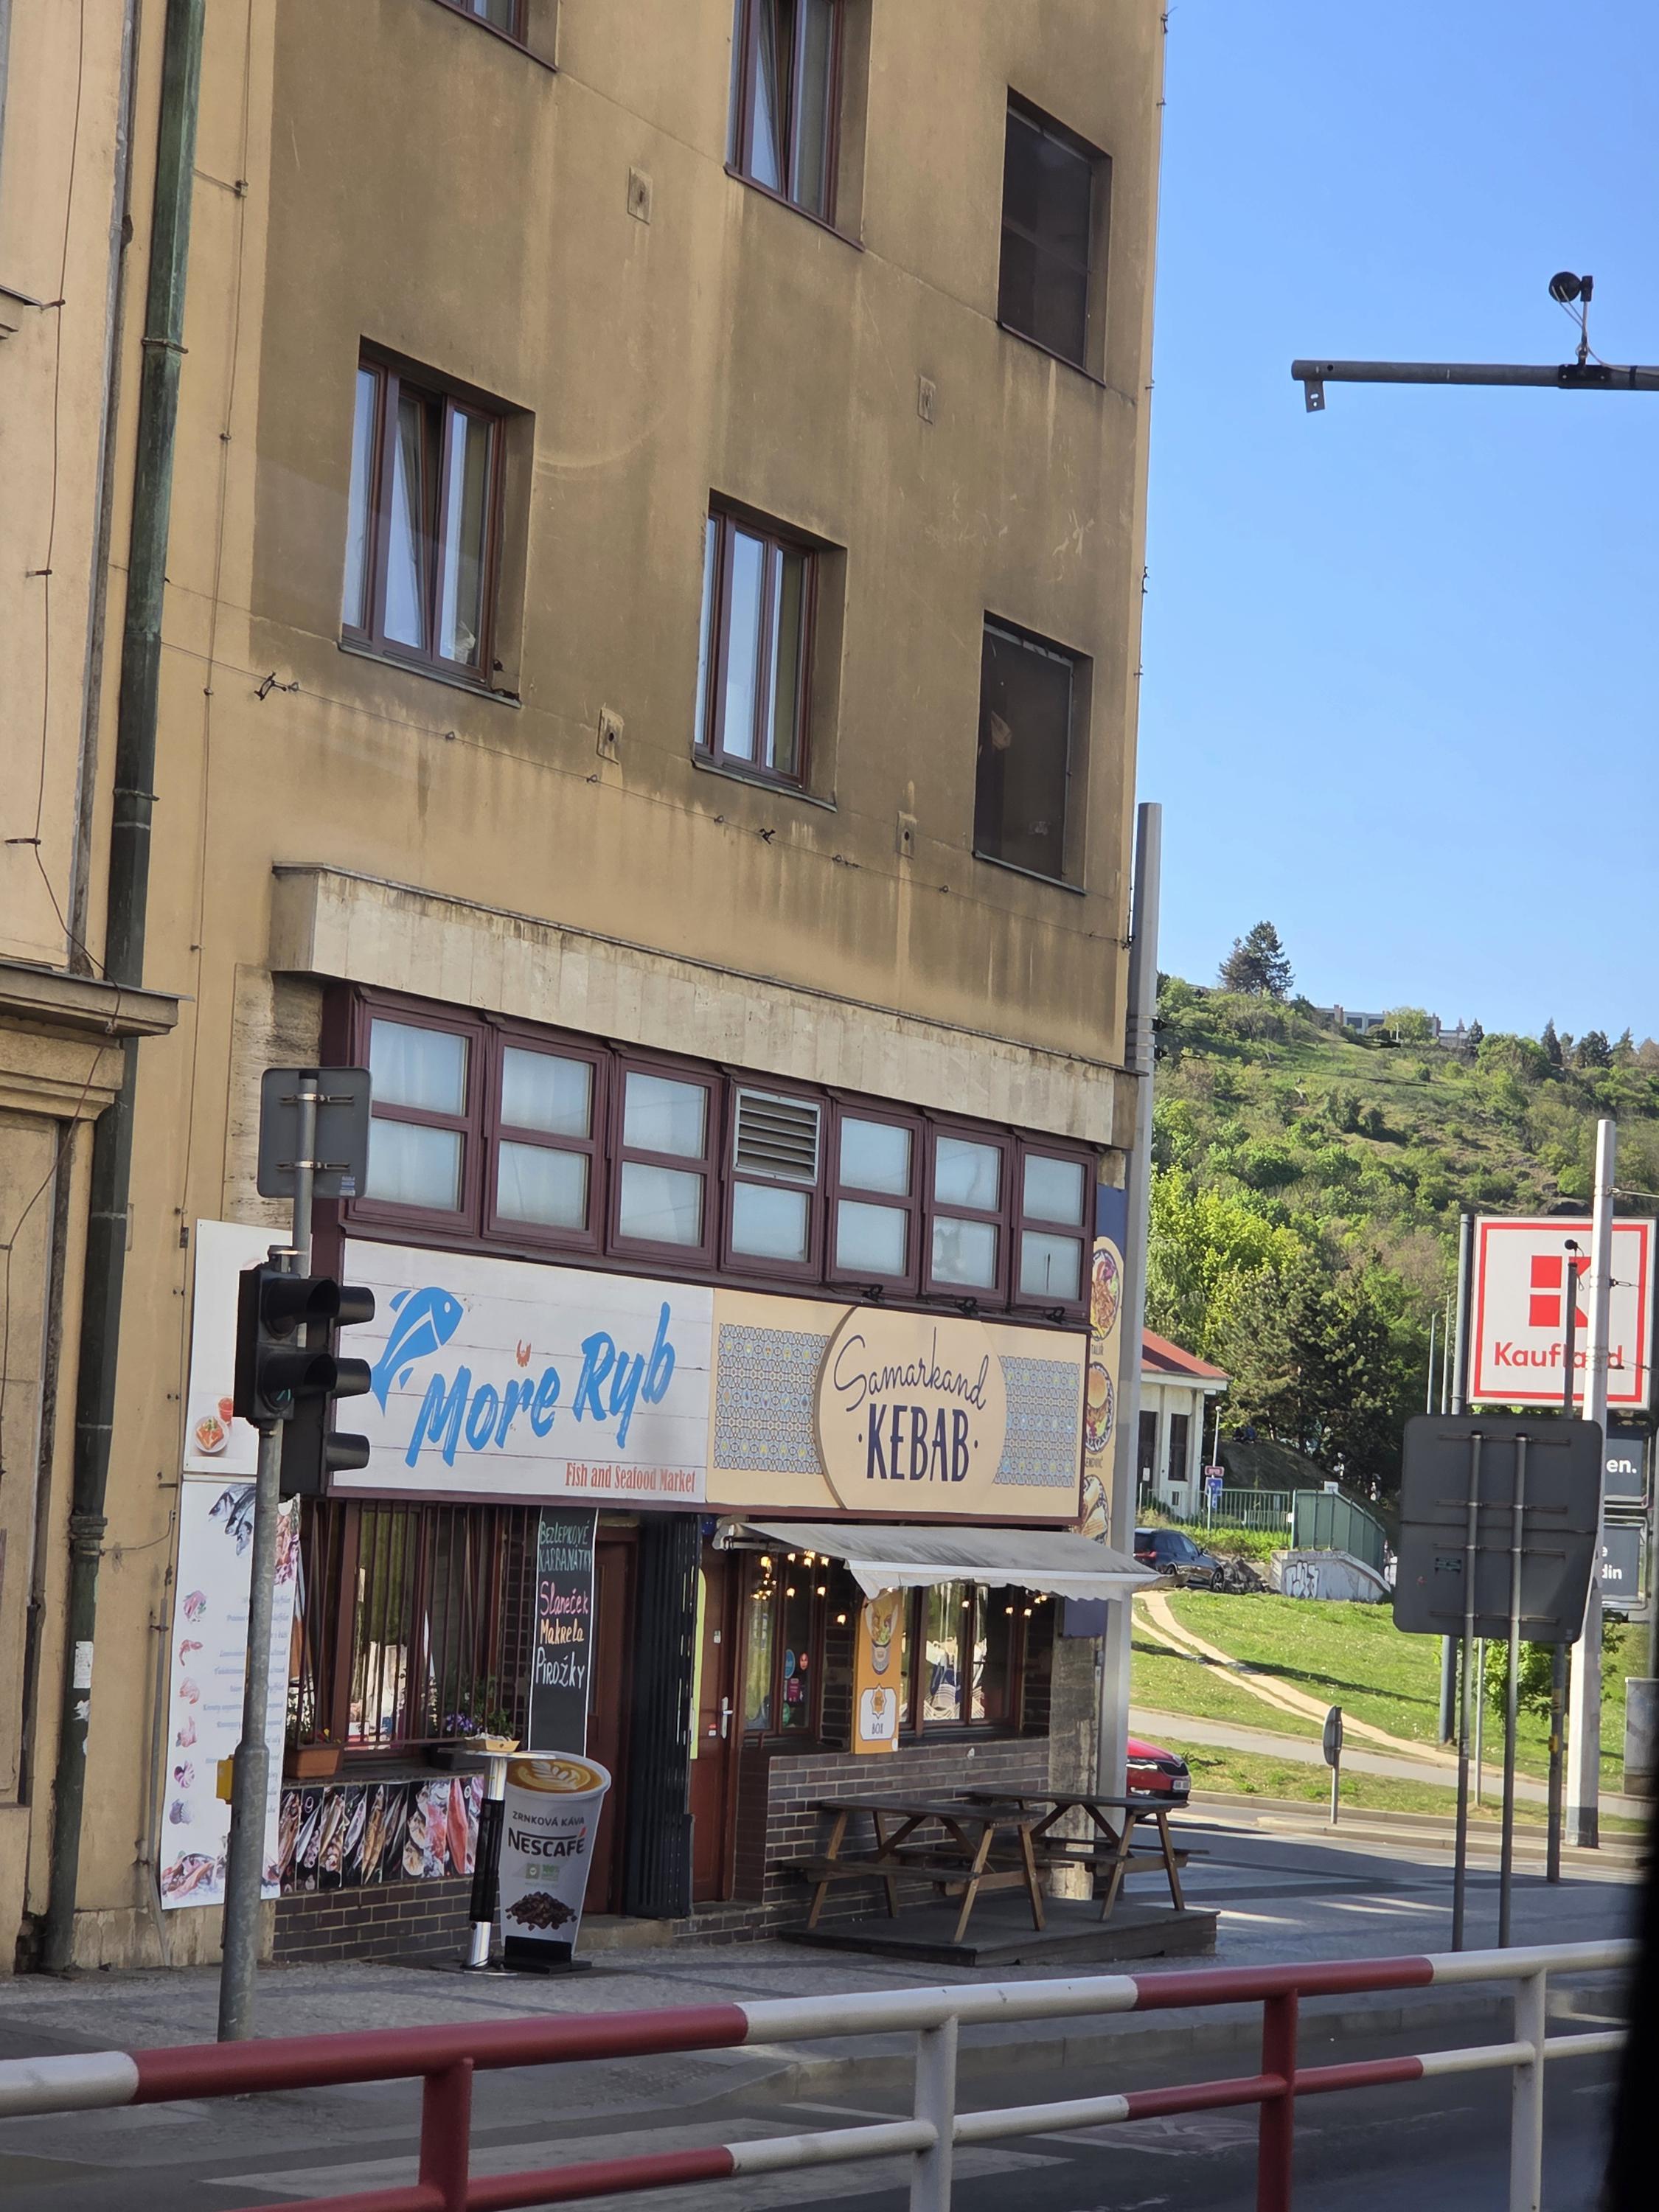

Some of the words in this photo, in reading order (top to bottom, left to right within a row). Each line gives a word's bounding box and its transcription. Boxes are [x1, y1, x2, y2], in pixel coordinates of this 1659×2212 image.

[572, 1301, 675, 1450] Ryb
[834, 1326, 989, 1412] Samarkand
[1494, 1341, 1623, 1369] Kauflad
[866, 1403, 970, 1482] KEBAB
[565, 1462, 588, 1486] Fish
[591, 1464, 612, 1488] and
[614, 1465, 656, 1490] Seafood
[659, 1468, 696, 1493] Market
[512, 1810, 558, 1826] ZRNKOVÁ
[561, 1816, 585, 1827] KÁVA
